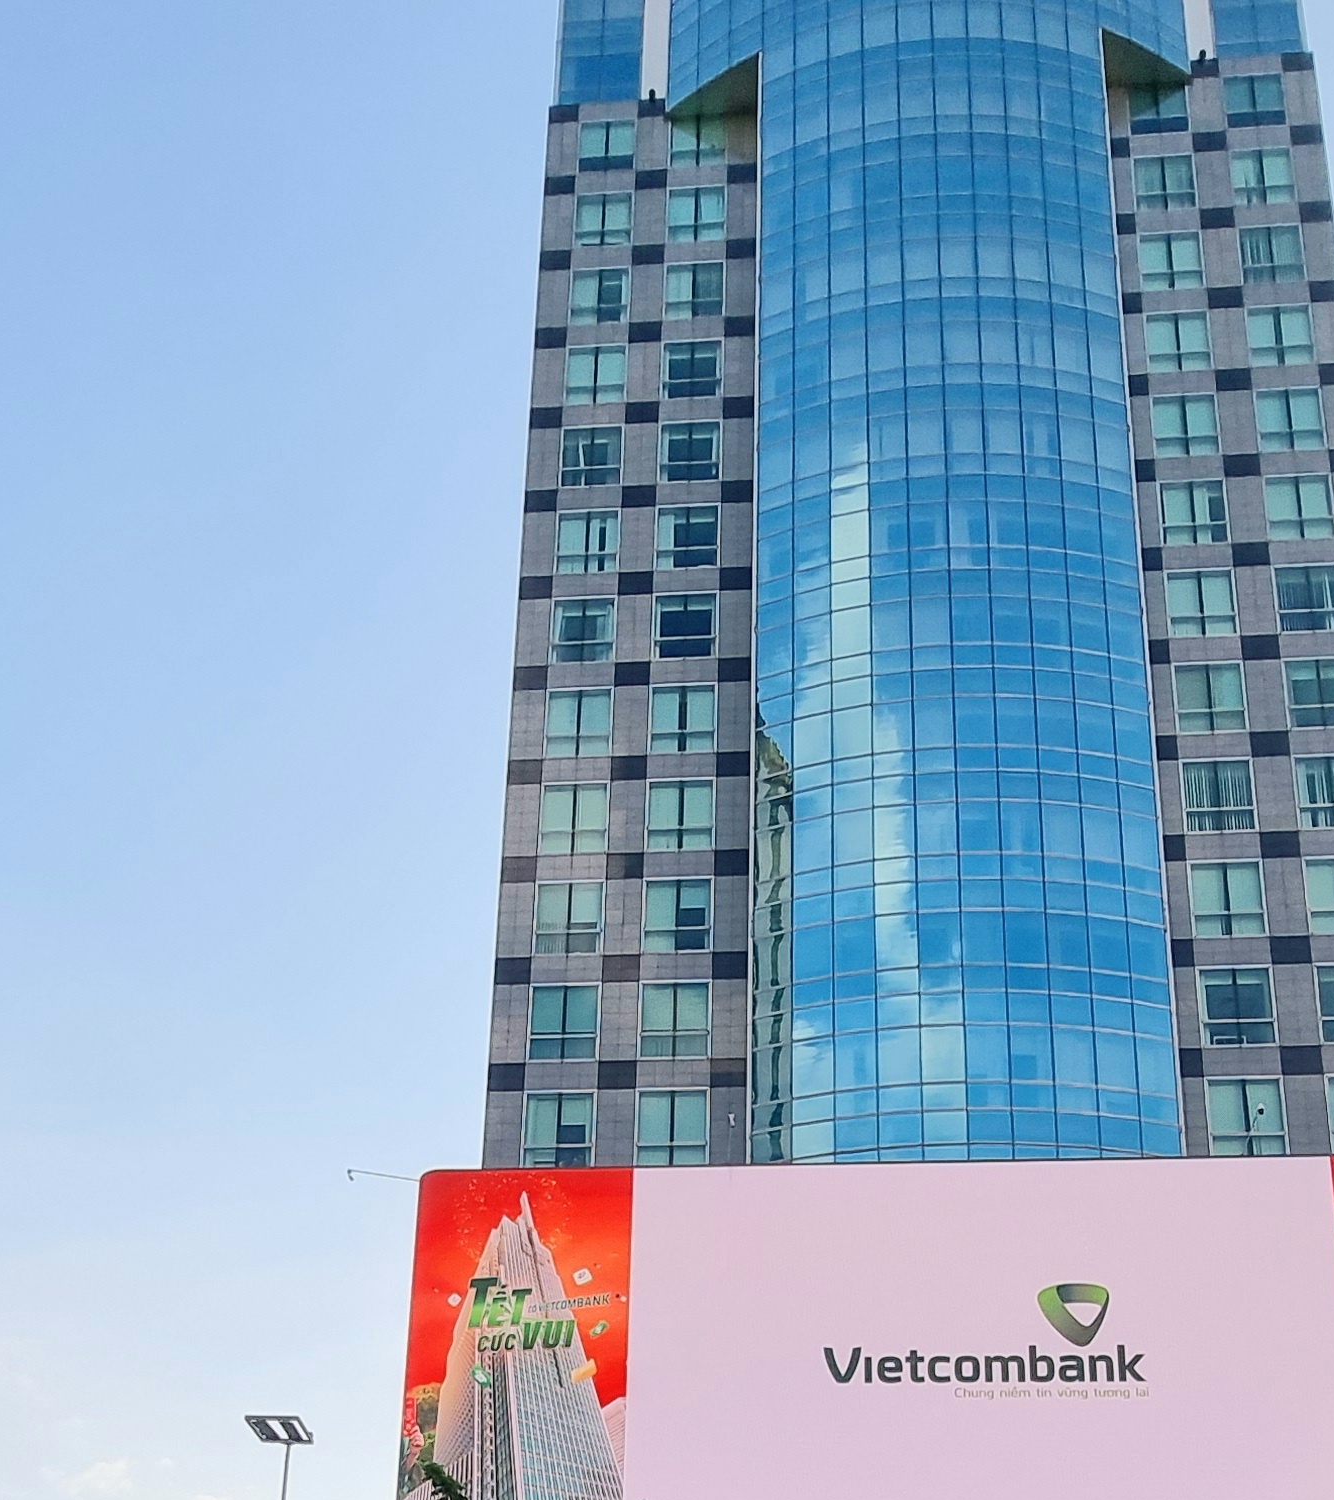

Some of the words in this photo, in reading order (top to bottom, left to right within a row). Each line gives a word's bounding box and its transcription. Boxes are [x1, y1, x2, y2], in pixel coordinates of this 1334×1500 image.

[468, 1277, 533, 1327] TẾT
[538, 1294, 610, 1311] VIETCOMBANK
[523, 1319, 576, 1350] VUI
[823, 1344, 1148, 1384] Vietcombank
[954, 1387, 995, 1400] Chung
[1036, 1387, 1053, 1398] tin
[1057, 1387, 1088, 1400] vững
[1135, 1387, 1150, 1398] lai
